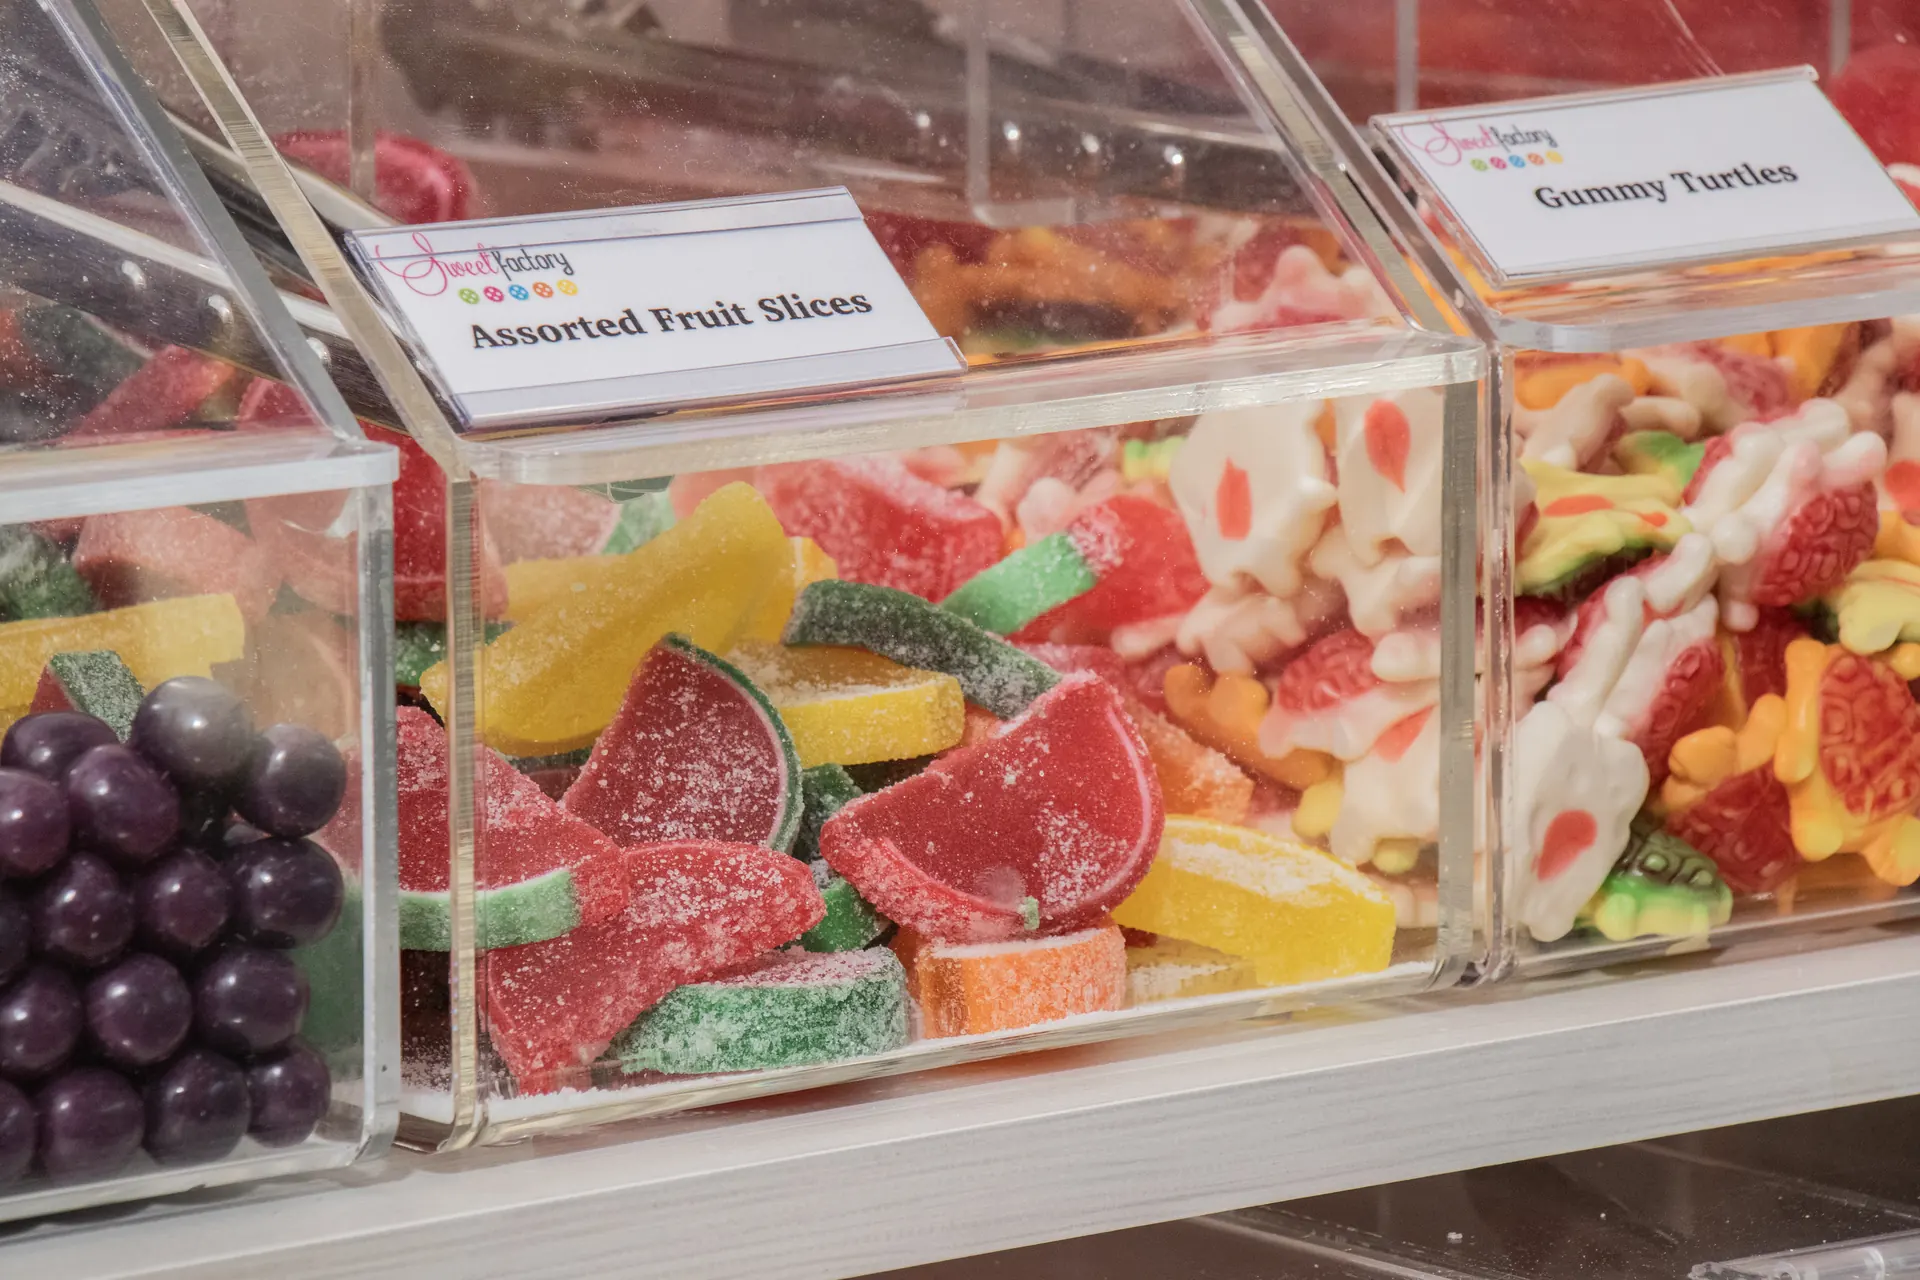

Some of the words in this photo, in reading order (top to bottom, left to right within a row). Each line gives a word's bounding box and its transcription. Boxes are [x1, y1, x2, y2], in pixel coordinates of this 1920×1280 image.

[1534, 180, 1668, 210] Gummy
[1669, 163, 1799, 195] Turtles
[471, 308, 648, 349] Assorted
[650, 300, 754, 334] Fruit
[757, 290, 874, 324] Slices
